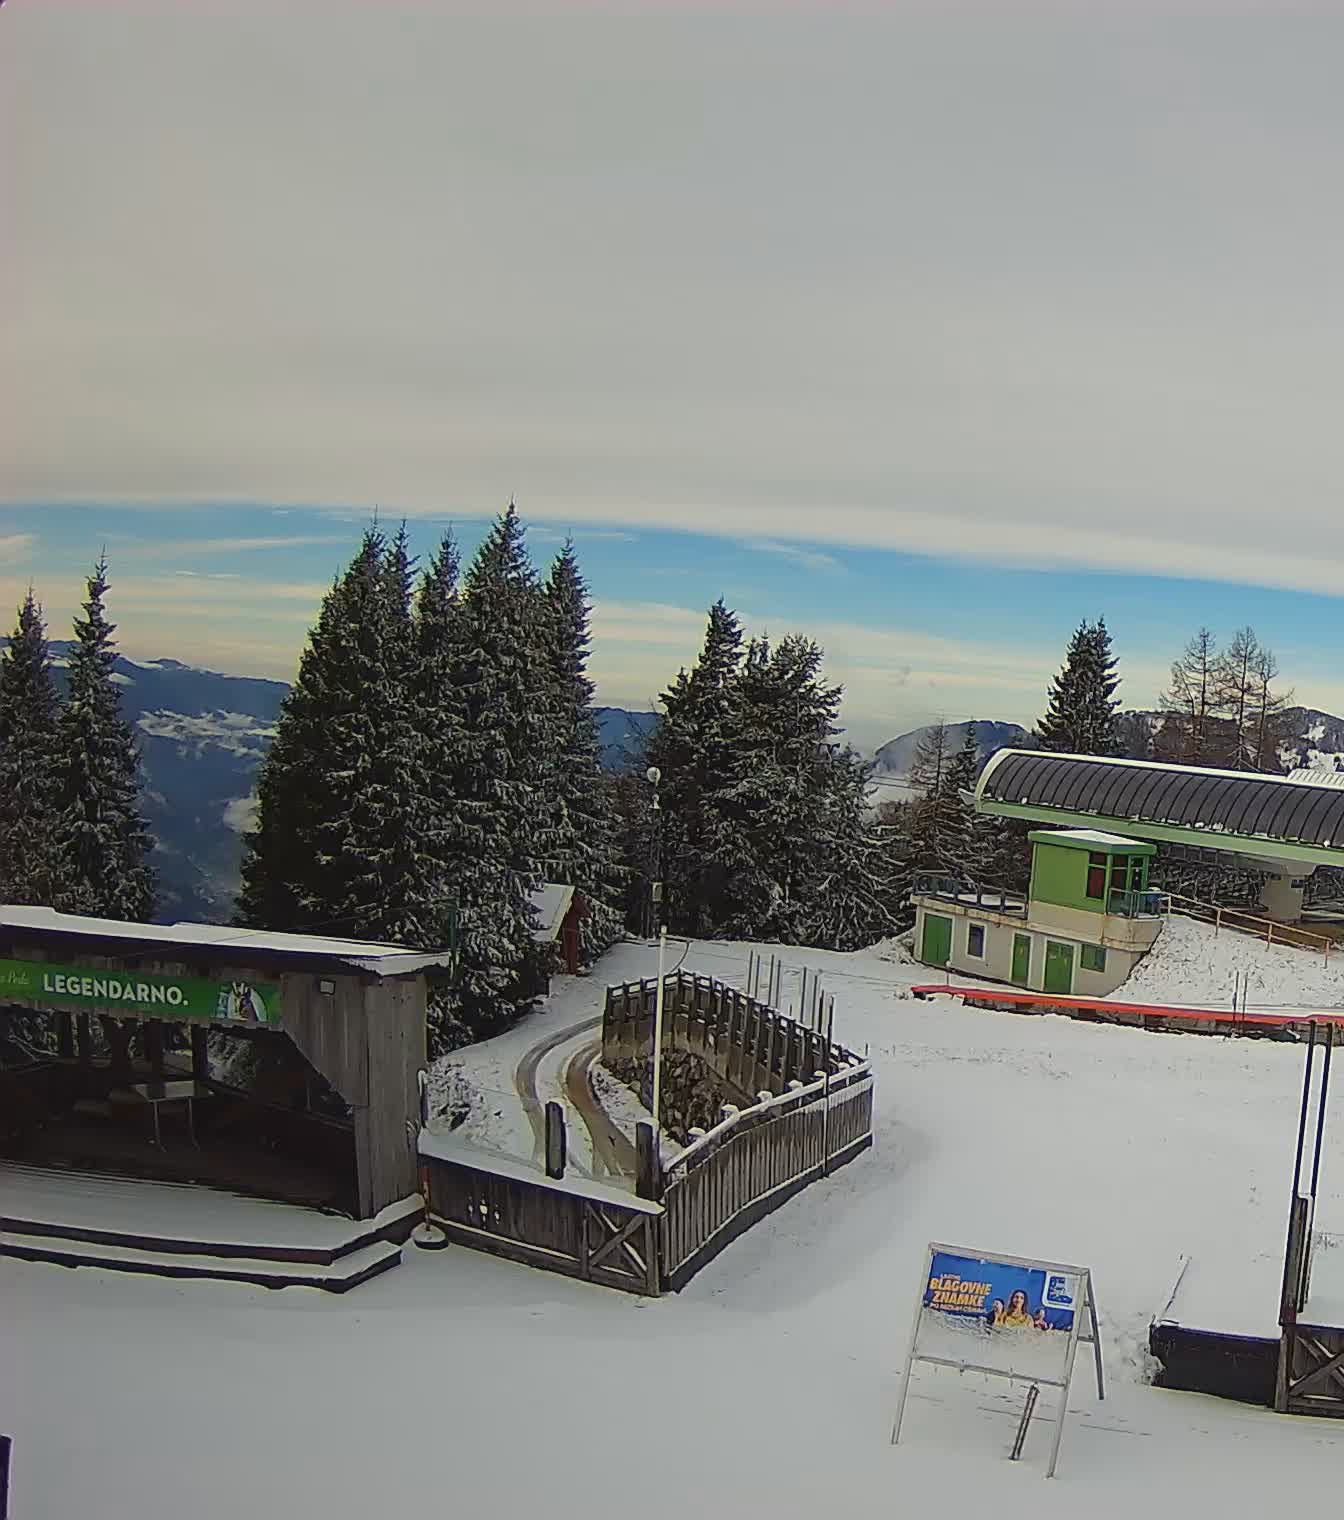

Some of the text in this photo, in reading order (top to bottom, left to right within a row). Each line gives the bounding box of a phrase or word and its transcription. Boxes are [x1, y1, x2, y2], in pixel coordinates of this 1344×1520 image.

[43, 972, 189, 1007] LEGENDARNO.
[929, 1277, 992, 1296] BLAGOVNE
[932, 1290, 985, 1307] ZNAMKE
